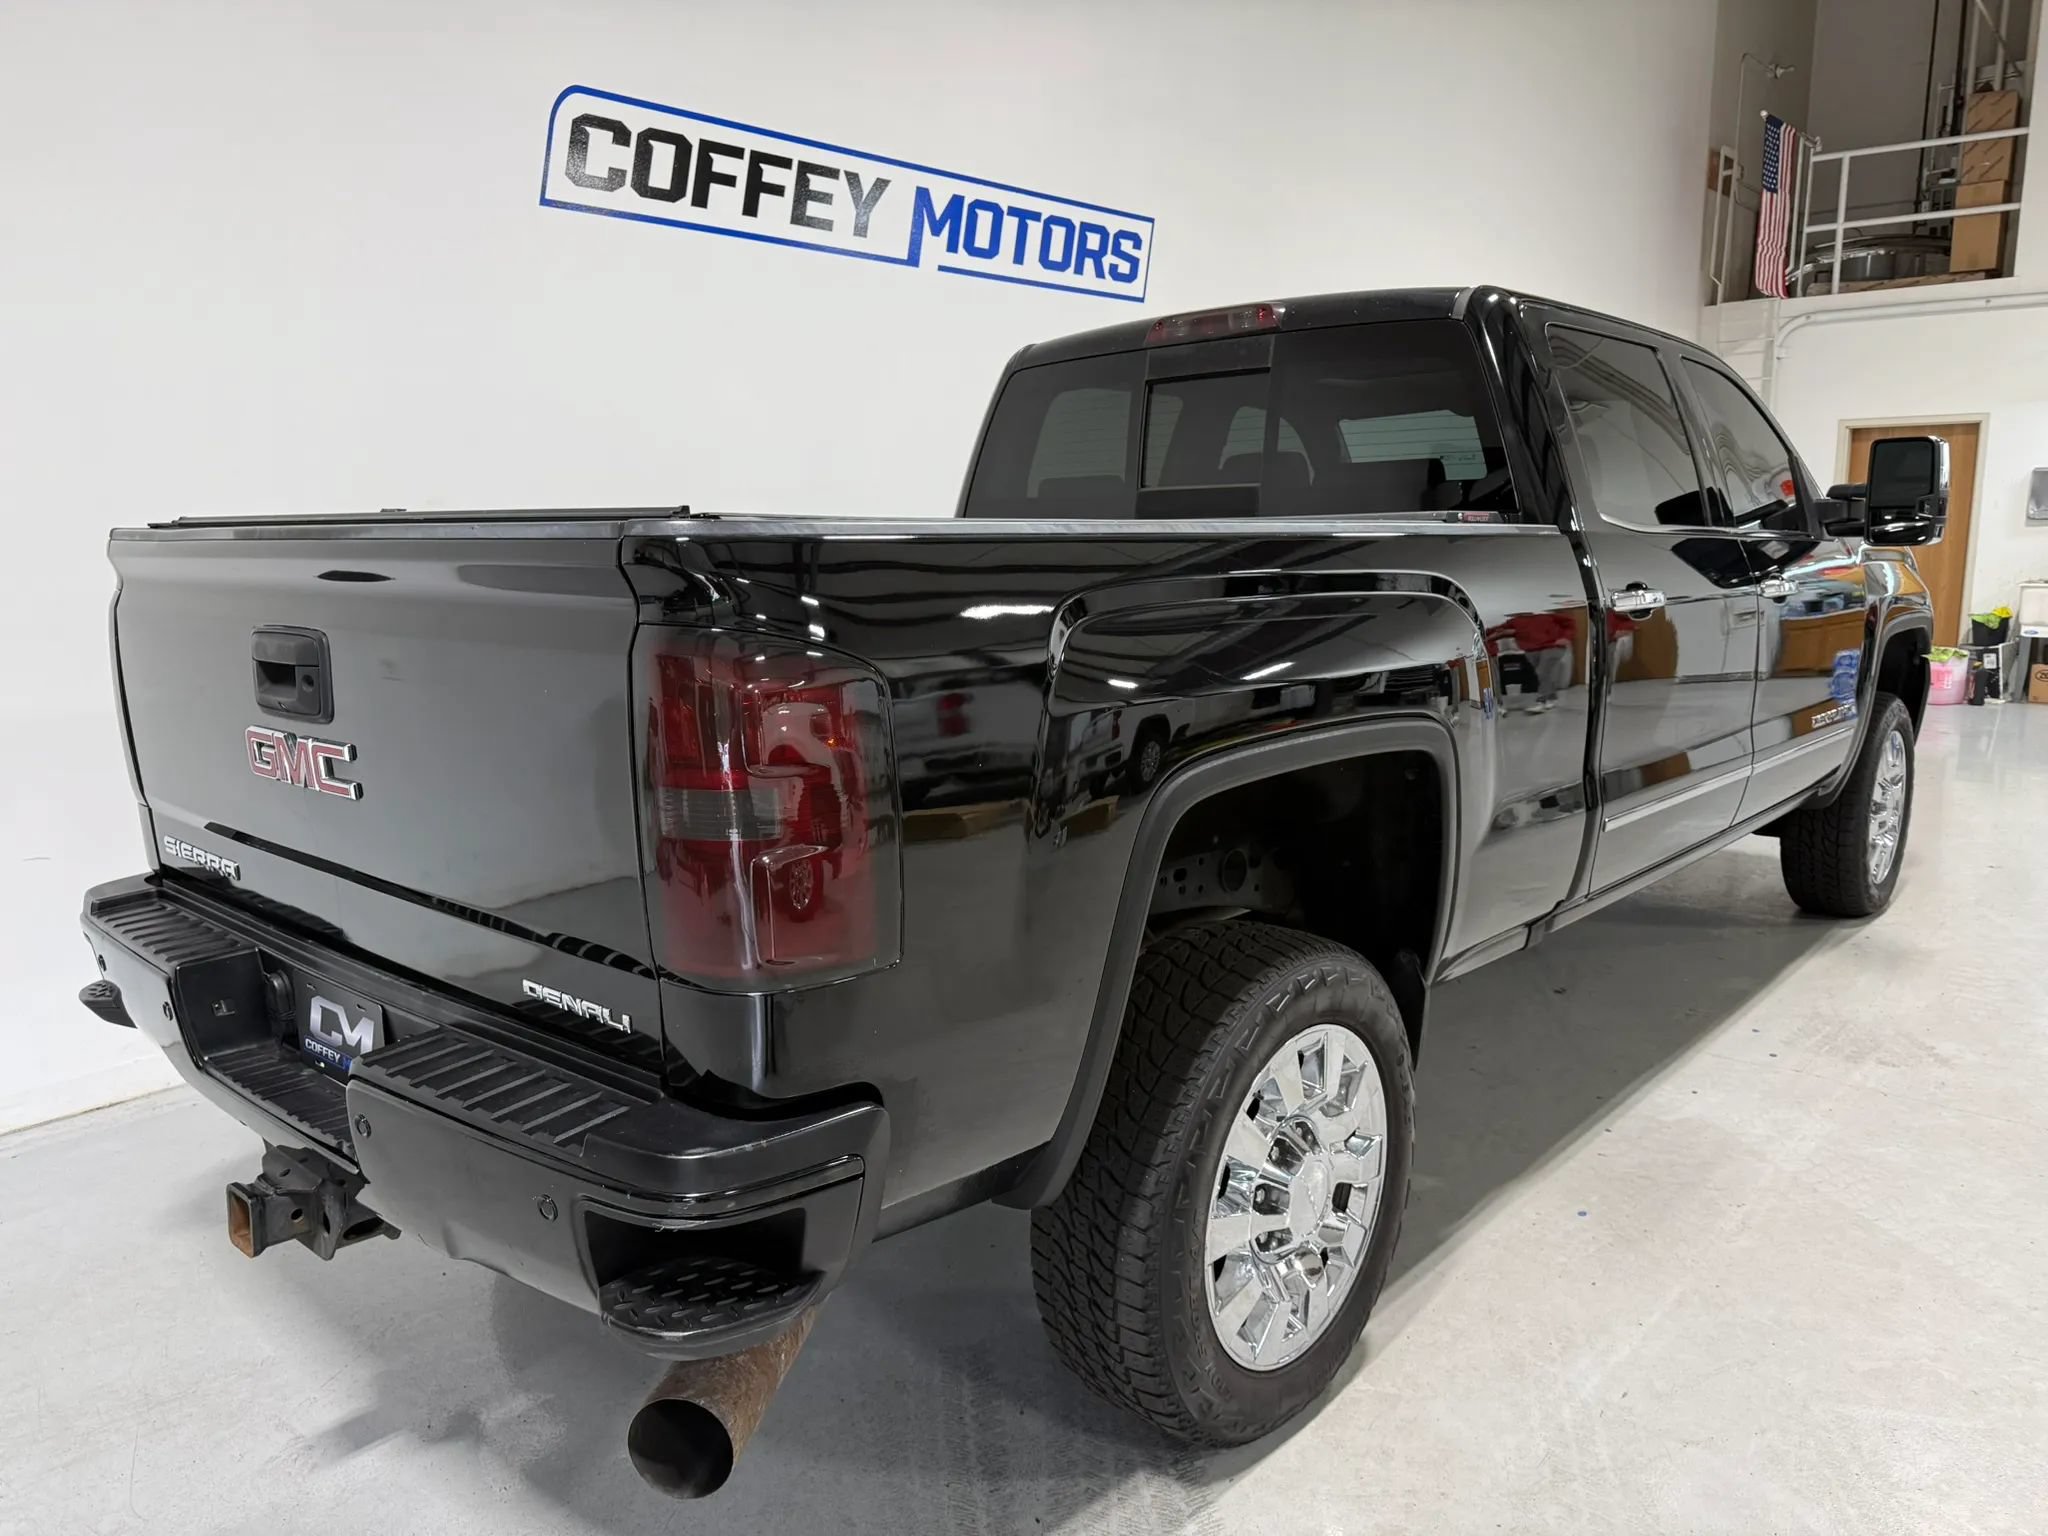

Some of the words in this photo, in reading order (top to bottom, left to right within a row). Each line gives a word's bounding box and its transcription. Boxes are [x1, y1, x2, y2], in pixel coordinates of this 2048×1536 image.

[564, 113, 891, 238] COFFEY
[907, 186, 1142, 283] MOTORS
[245, 725, 364, 801] GMC
[163, 836, 241, 880] SIERRA
[310, 996, 374, 1055] CM
[522, 979, 632, 1034] DENALI
[304, 1038, 340, 1063] COFFEY
